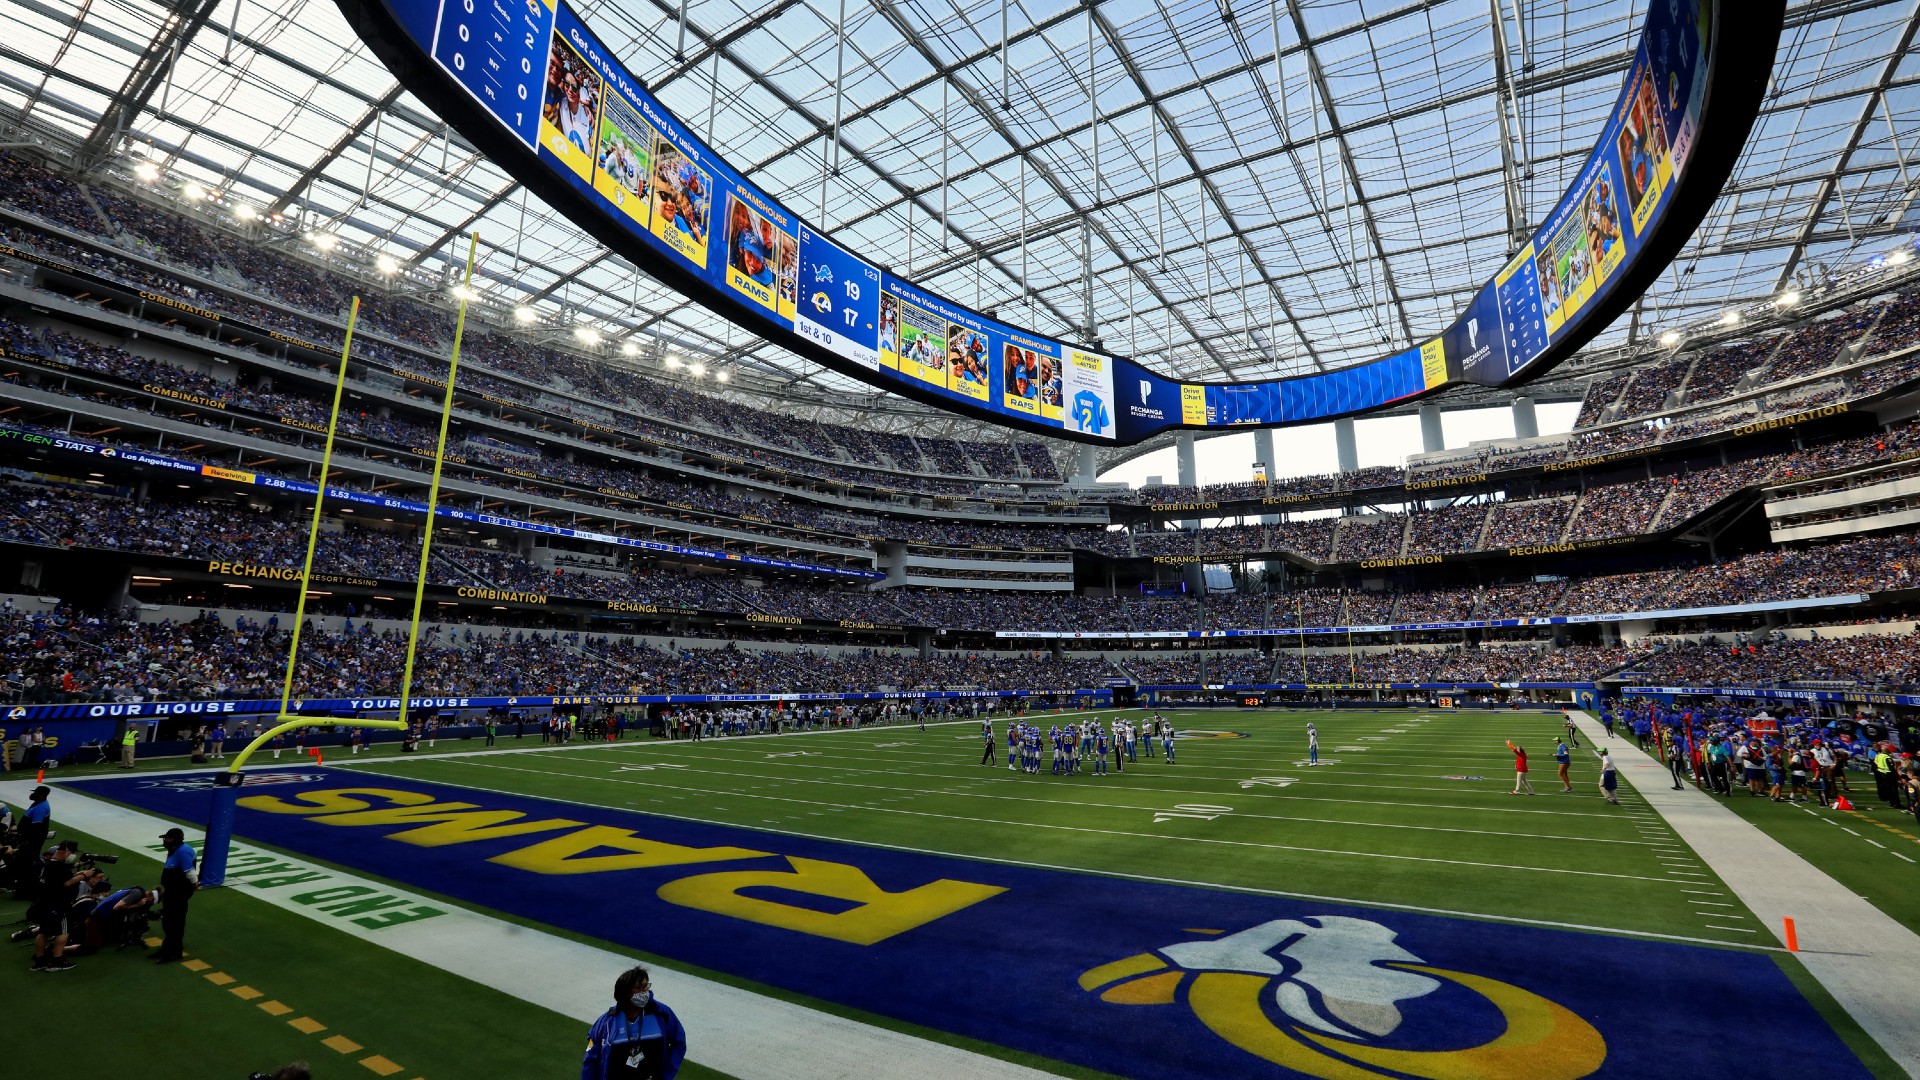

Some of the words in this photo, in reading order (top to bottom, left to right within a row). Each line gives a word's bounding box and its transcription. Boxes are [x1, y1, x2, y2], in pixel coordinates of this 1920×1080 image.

[524, 14, 540, 34] Rams
[458, 24, 469, 42] 0
[494, 32, 503, 42] FF
[524, 32, 534, 50] 2
[454, 52, 465, 71] 0
[488, 58, 501, 71] INT
[521, 57, 531, 74] 0
[484, 85, 496, 100] TFL
[518, 84, 528, 100] 0
[570, 28, 588, 53] Get
[589, 51, 601, 67] on
[602, 61, 617, 82] the
[617, 75, 642, 107] Video
[643, 101, 667, 129] Board
[668, 124, 678, 141] by
[678, 135, 700, 161] using
[516, 112, 523, 127] 1
[736, 184, 787, 227] #RAMSHOUSE
[1540, 232, 1549, 244] Get
[1549, 226, 1554, 235] on
[1554, 216, 1562, 227] the
[1562, 201, 1574, 218] Video
[1573, 183, 1586, 202] Board
[1585, 177, 1591, 186] by
[1590, 156, 1602, 176] using
[1637, 187, 1657, 224] RAMS
[664, 223, 678, 237] LOS
[802, 231, 810, 240] Q3
[663, 230, 696, 255] ANGELES
[663, 234, 684, 252] RAMS
[19, 253, 46, 265] RESORT
[48, 262, 73, 274] CASINO
[1506, 258, 1523, 276] Defense
[864, 268, 878, 282] 1:23
[734, 275, 770, 302] RAMS
[844, 279, 860, 301] 19
[1529, 286, 1534, 296] 2
[139, 291, 220, 321] COMBINATION
[890, 282, 902, 295] Get
[902, 289, 911, 298] on
[911, 293, 921, 304] the
[921, 298, 939, 312] Video
[939, 306, 957, 319] Board
[957, 313, 966, 324] by
[965, 317, 982, 330] using
[1508, 306, 1511, 314] 1
[1532, 303, 1537, 312] 0
[843, 307, 859, 328] 17
[799, 321, 812, 336] 1st
[813, 328, 820, 339] &
[821, 332, 832, 345] 10
[1510, 322, 1514, 332] 0
[1534, 320, 1539, 330] 0
[270, 331, 316, 350] PECHANGA
[1010, 334, 1052, 353] #RAMSHOUSE
[1512, 339, 1517, 348] 0
[1538, 337, 1542, 346] 1
[1423, 345, 1436, 354] Last
[1462, 345, 1490, 366] PECHANGA
[10, 351, 39, 363] RESORT
[41, 359, 70, 371] CASINO
[869, 355, 878, 365] 25
[1082, 355, 1099, 363] JERSEY
[1424, 353, 1436, 362] Play
[1514, 355, 1519, 364] 0
[1463, 360, 1477, 371] RESORT
[393, 369, 449, 389] COMBINATION
[143, 383, 226, 409] COMBINATION
[482, 394, 515, 408] PECHANGA
[1130, 405, 1163, 415] PECHANGA
[280, 417, 329, 433] PECHANGA
[1082, 408, 1092, 428] 2
[1733, 403, 1849, 437] COMBINATION
[573, 419, 614, 434] COMBINATION
[23, 433, 53, 445] GEN
[54, 440, 95, 453] STATS
[121, 452, 137, 461] Los
[138, 456, 172, 467] Angeles
[173, 463, 196, 471] Rams
[1543, 455, 1605, 472] PECHANGA
[1607, 452, 1634, 460] RESORT
[1635, 446, 1662, 455] CASINO
[210, 469, 247, 481] Receiving
[503, 467, 537, 478] PECHANGA
[1770, 474, 1812, 486] PECHANGA
[265, 478, 285, 487] 2.88
[1405, 474, 1486, 491] COMBINATION
[330, 490, 349, 499] 5.53
[598, 487, 639, 499] COMBINATION
[1262, 494, 1311, 505] PECHANGA
[667, 501, 692, 510] PECHANGA
[1151, 502, 1218, 512] COMBINATION
[1509, 543, 1576, 557] PECHANGA
[1608, 537, 1636, 545] CASINO
[1154, 555, 1201, 564] PECHANGA
[1360, 556, 1443, 569] COMBINATION
[208, 561, 305, 581] PECHANGA
[310, 574, 344, 583] RESORT
[347, 577, 378, 587] CASINO
[457, 586, 547, 605] COMBINATION
[607, 602, 657, 614] PECHANGA
[746, 614, 802, 625] COMBINATION
[840, 620, 874, 630] PECHANGA
[1721, 688, 1735, 696] OUR
[1736, 689, 1755, 697] HOUSE
[1774, 690, 1792, 699] YOUR
[1794, 691, 1817, 700] HOUSE
[1844, 693, 1867, 703] RAMS
[1869, 694, 1897, 704] HOUSE
[350, 699, 400, 709] YOUR
[410, 698, 470, 707] HOUSE
[552, 697, 591, 705] RAMS
[1440, 698, 1452, 706] 33
[89, 704, 143, 717] OUR
[155, 702, 236, 715] HOUSE
[1064, 737, 1073, 745] 89
[1102, 739, 1107, 748] 9
[235, 787, 1010, 946] RAMS
[288, 885, 448, 930] END
